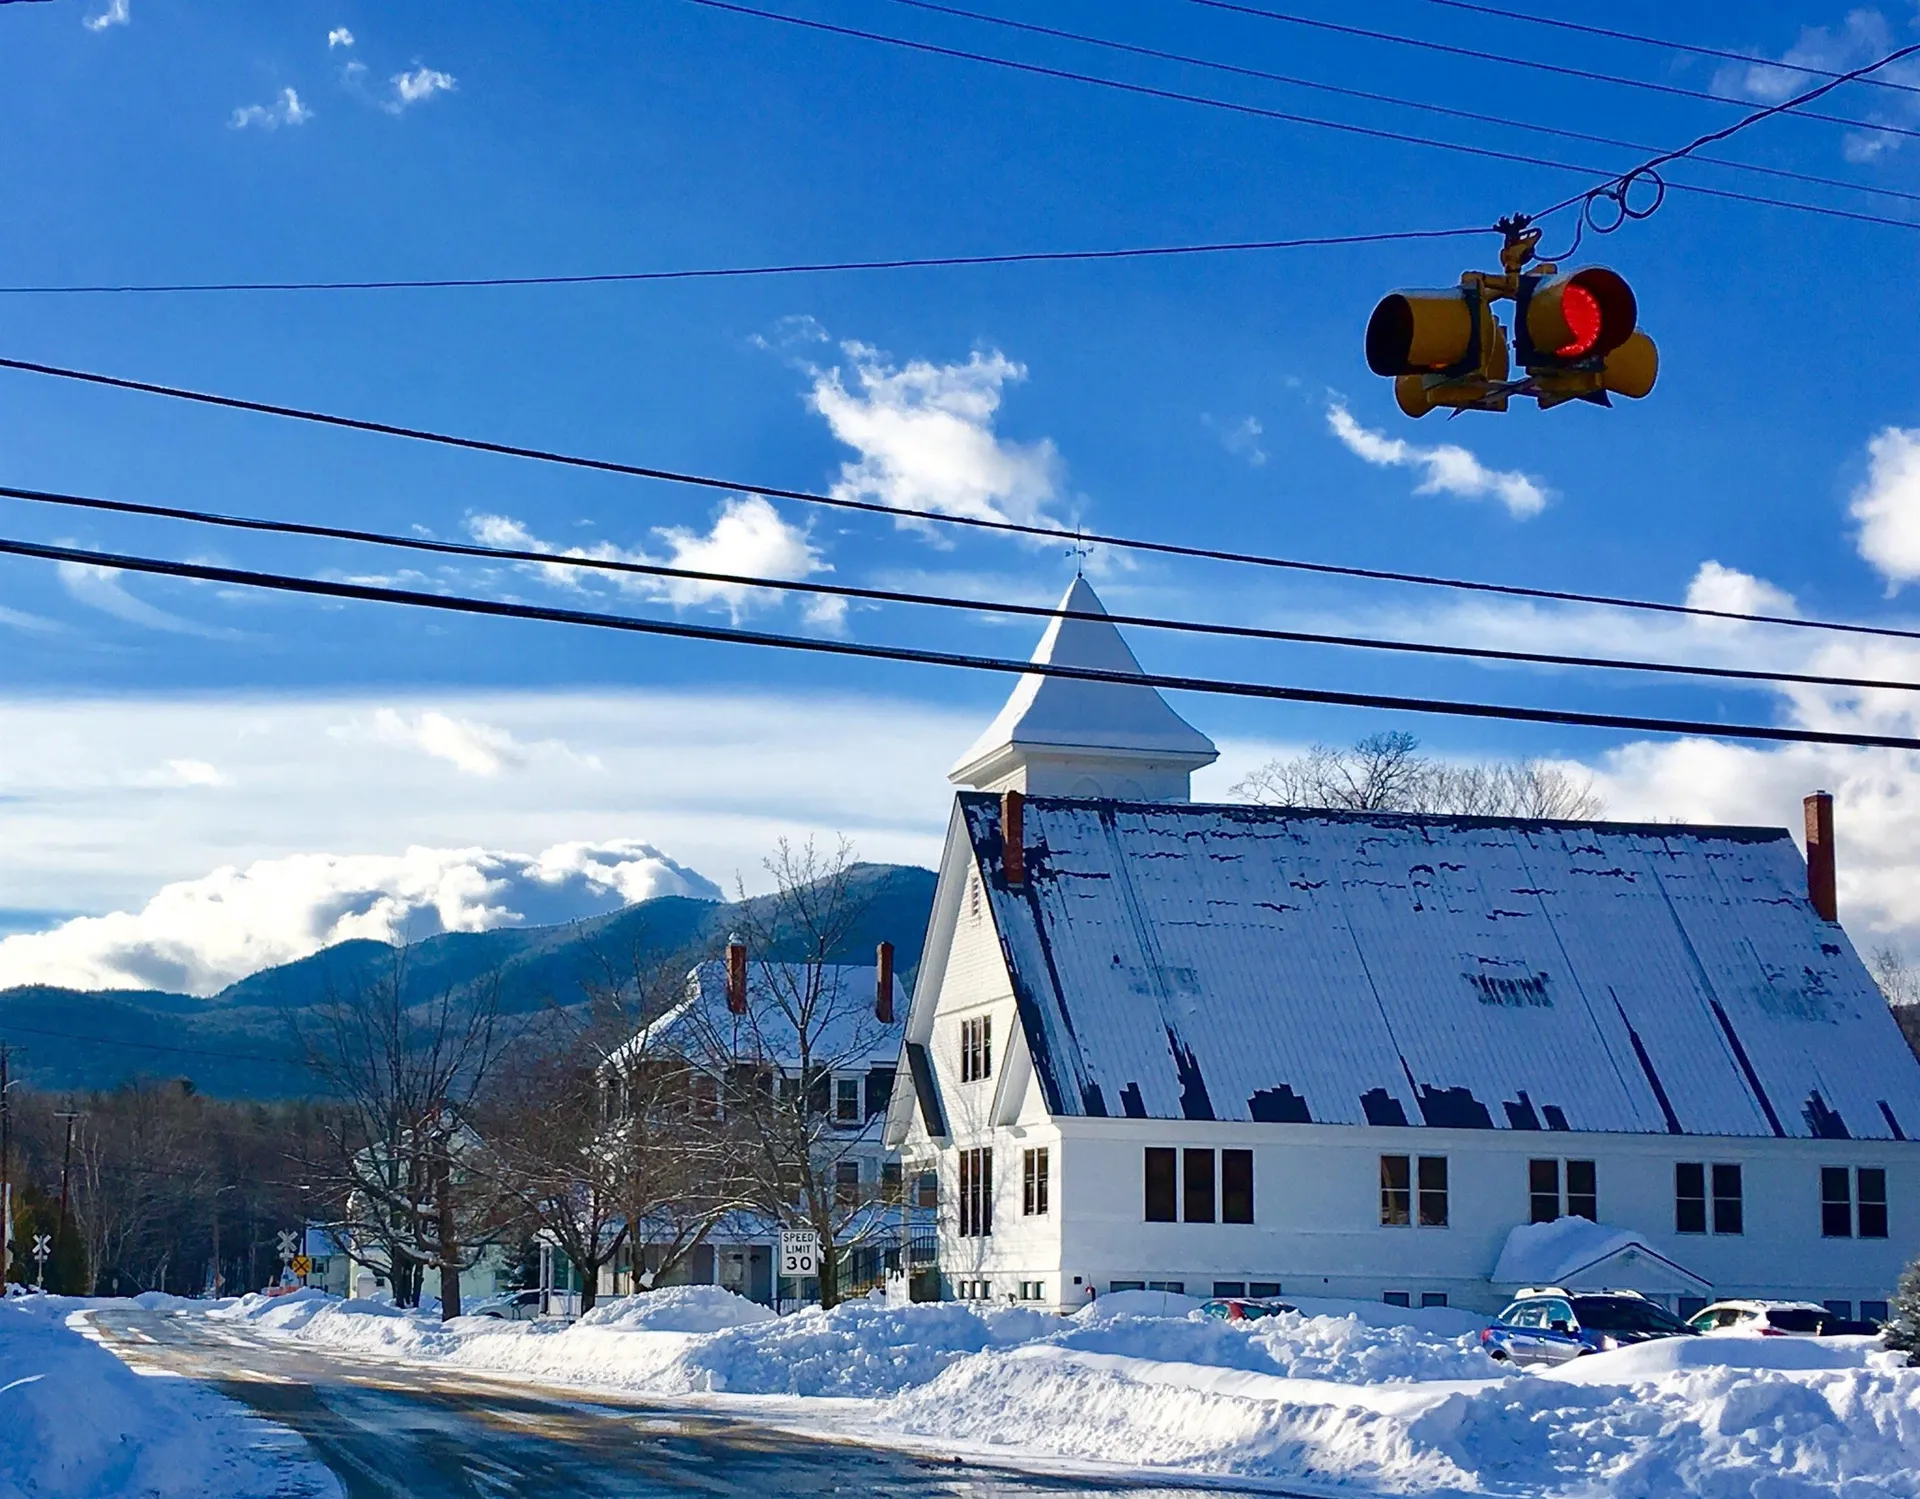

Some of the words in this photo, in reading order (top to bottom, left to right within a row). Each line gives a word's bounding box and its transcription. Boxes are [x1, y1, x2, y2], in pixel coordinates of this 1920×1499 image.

[783, 1233, 814, 1242] SPEED
[786, 1245, 811, 1254] LIMIT
[786, 1256, 812, 1271] 30
